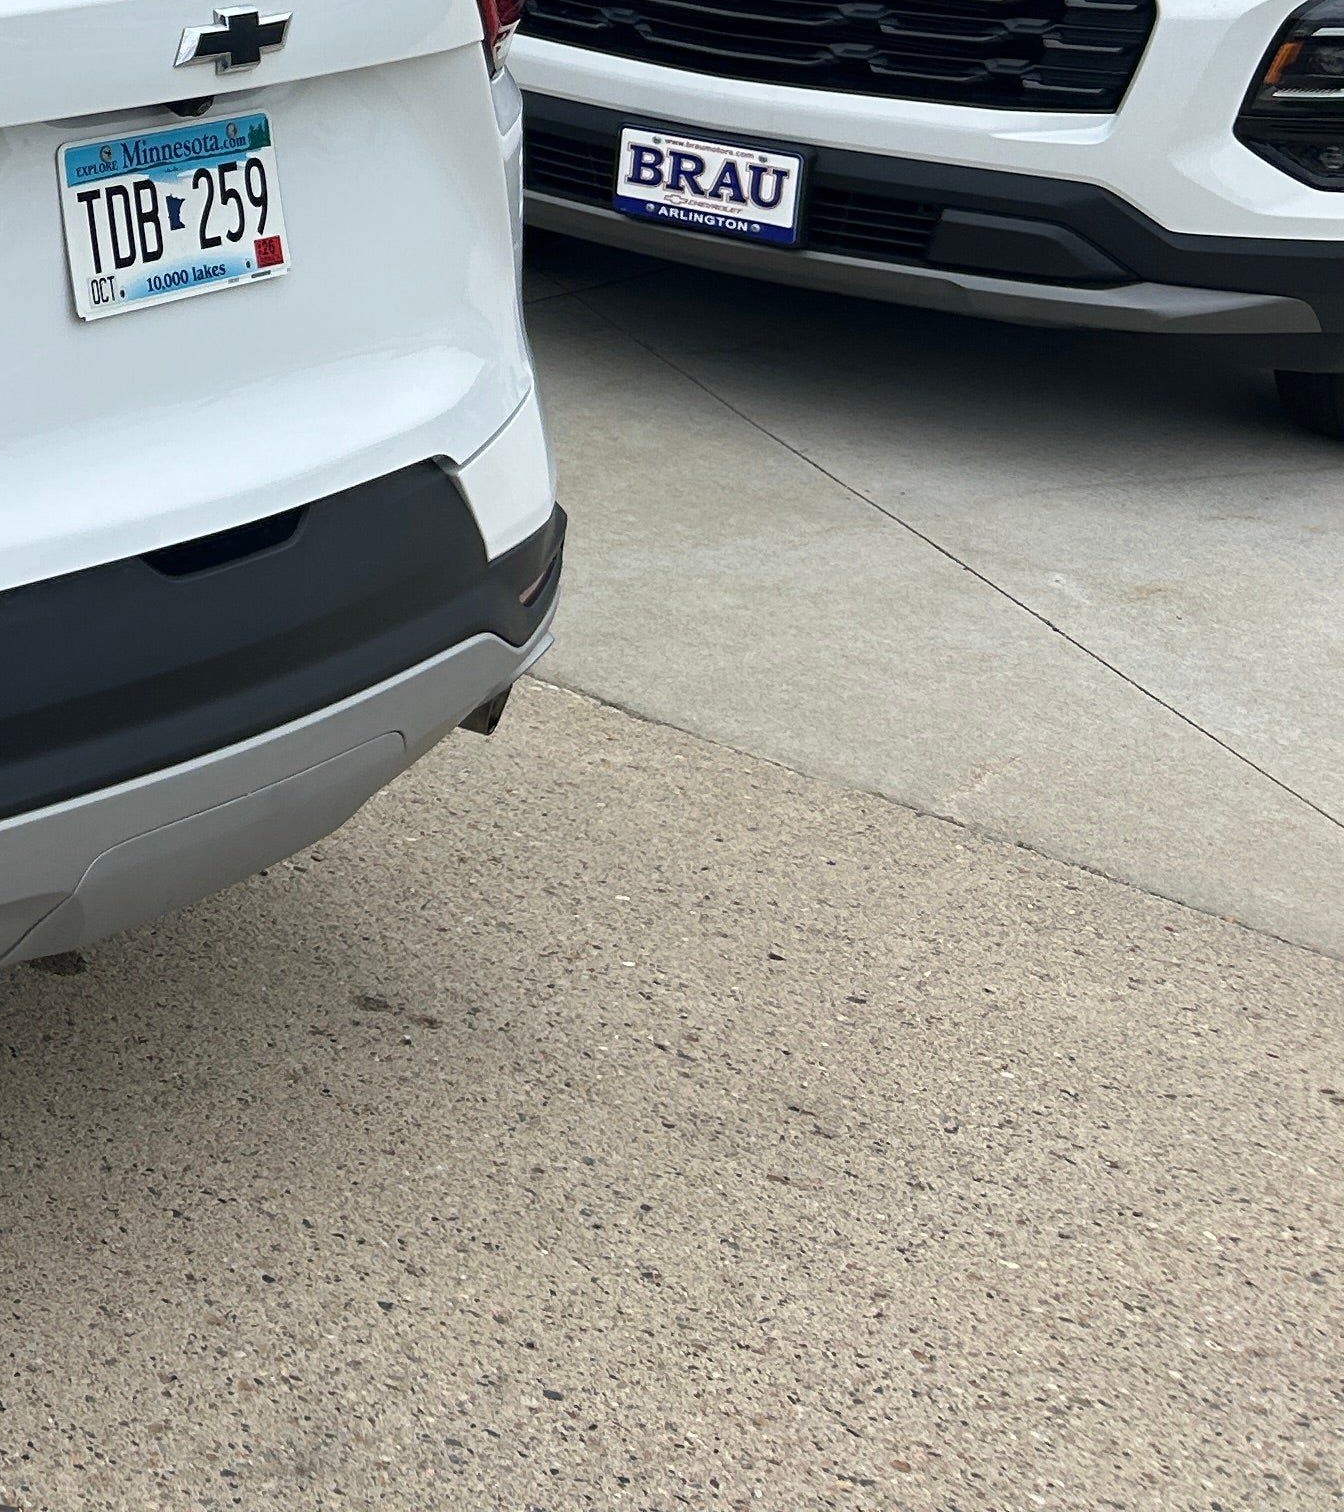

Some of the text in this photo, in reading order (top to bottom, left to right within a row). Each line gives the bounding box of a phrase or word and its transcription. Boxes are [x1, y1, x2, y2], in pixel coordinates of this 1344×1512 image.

[121, 133, 246, 169] Minnesota.com
[625, 142, 790, 210] BRAU
[76, 157, 268, 275] TDB 259
[658, 205, 748, 232] ARLINGTON
[147, 264, 226, 292] 10,000 lakes
